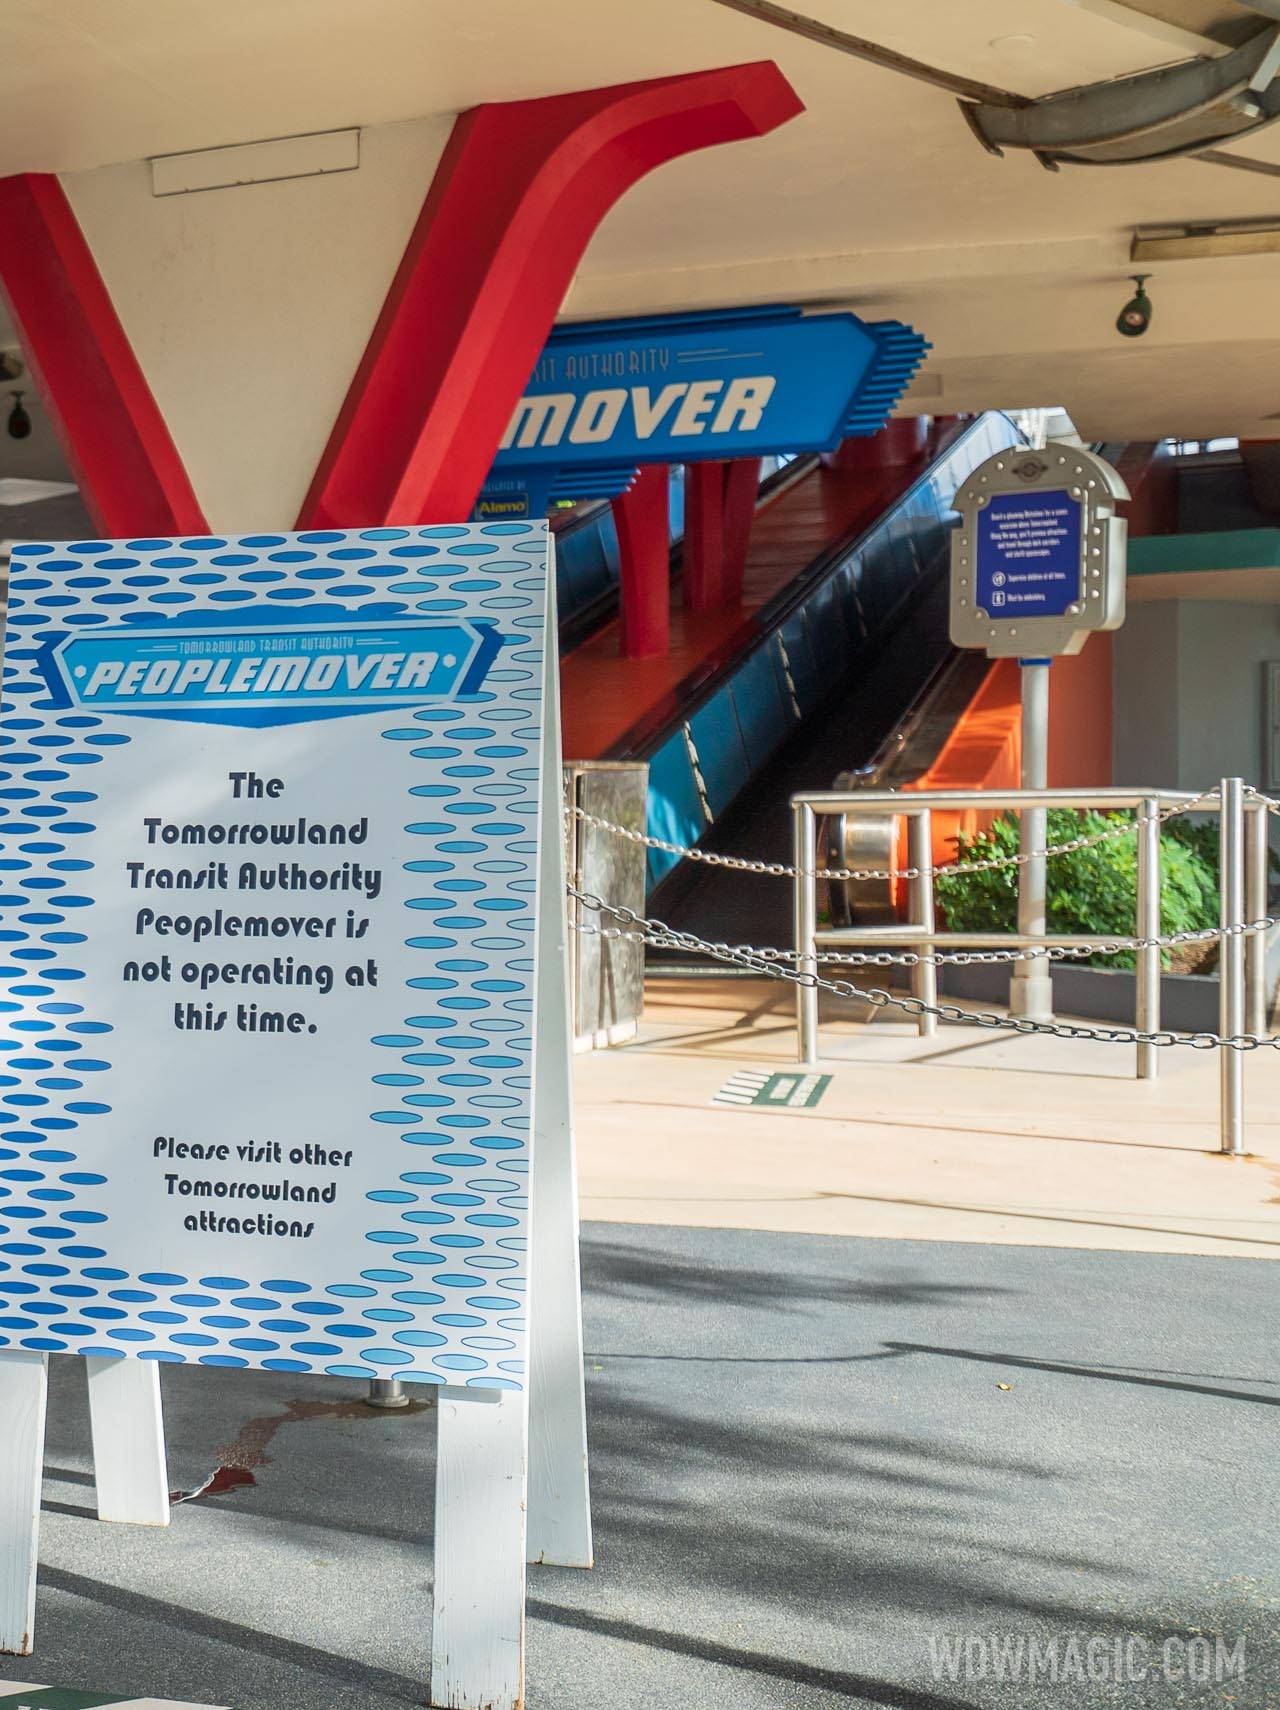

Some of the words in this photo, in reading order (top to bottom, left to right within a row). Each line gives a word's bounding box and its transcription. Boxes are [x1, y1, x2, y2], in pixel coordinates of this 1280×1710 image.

[565, 348, 670, 381] AUTHORITY
[497, 375, 777, 451] MOVER
[179, 639, 257, 655] TOMORROWLAND
[259, 637, 298, 652] TRANSIT
[300, 635, 354, 651] AUTHORITY
[83, 652, 440, 696] PEOPLEMOVER
[229, 772, 285, 799] The
[143, 817, 369, 845] Tomorrowland
[126, 861, 229, 890] Transit
[238, 861, 382, 900] Authority
[135, 907, 337, 943] Peoplemover
[345, 909, 370, 939] is
[122, 955, 172, 983] not
[180, 956, 334, 995] operating
[344, 958, 379, 987] at
[174, 1002, 228, 1032] this
[236, 1003, 318, 1035] time.
[153, 1136, 231, 1161] Please
[236, 1139, 282, 1164] visit
[289, 1143, 354, 1167] other
[164, 1173, 337, 1204] Tomorrowland
[183, 1210, 316, 1239] attractions
